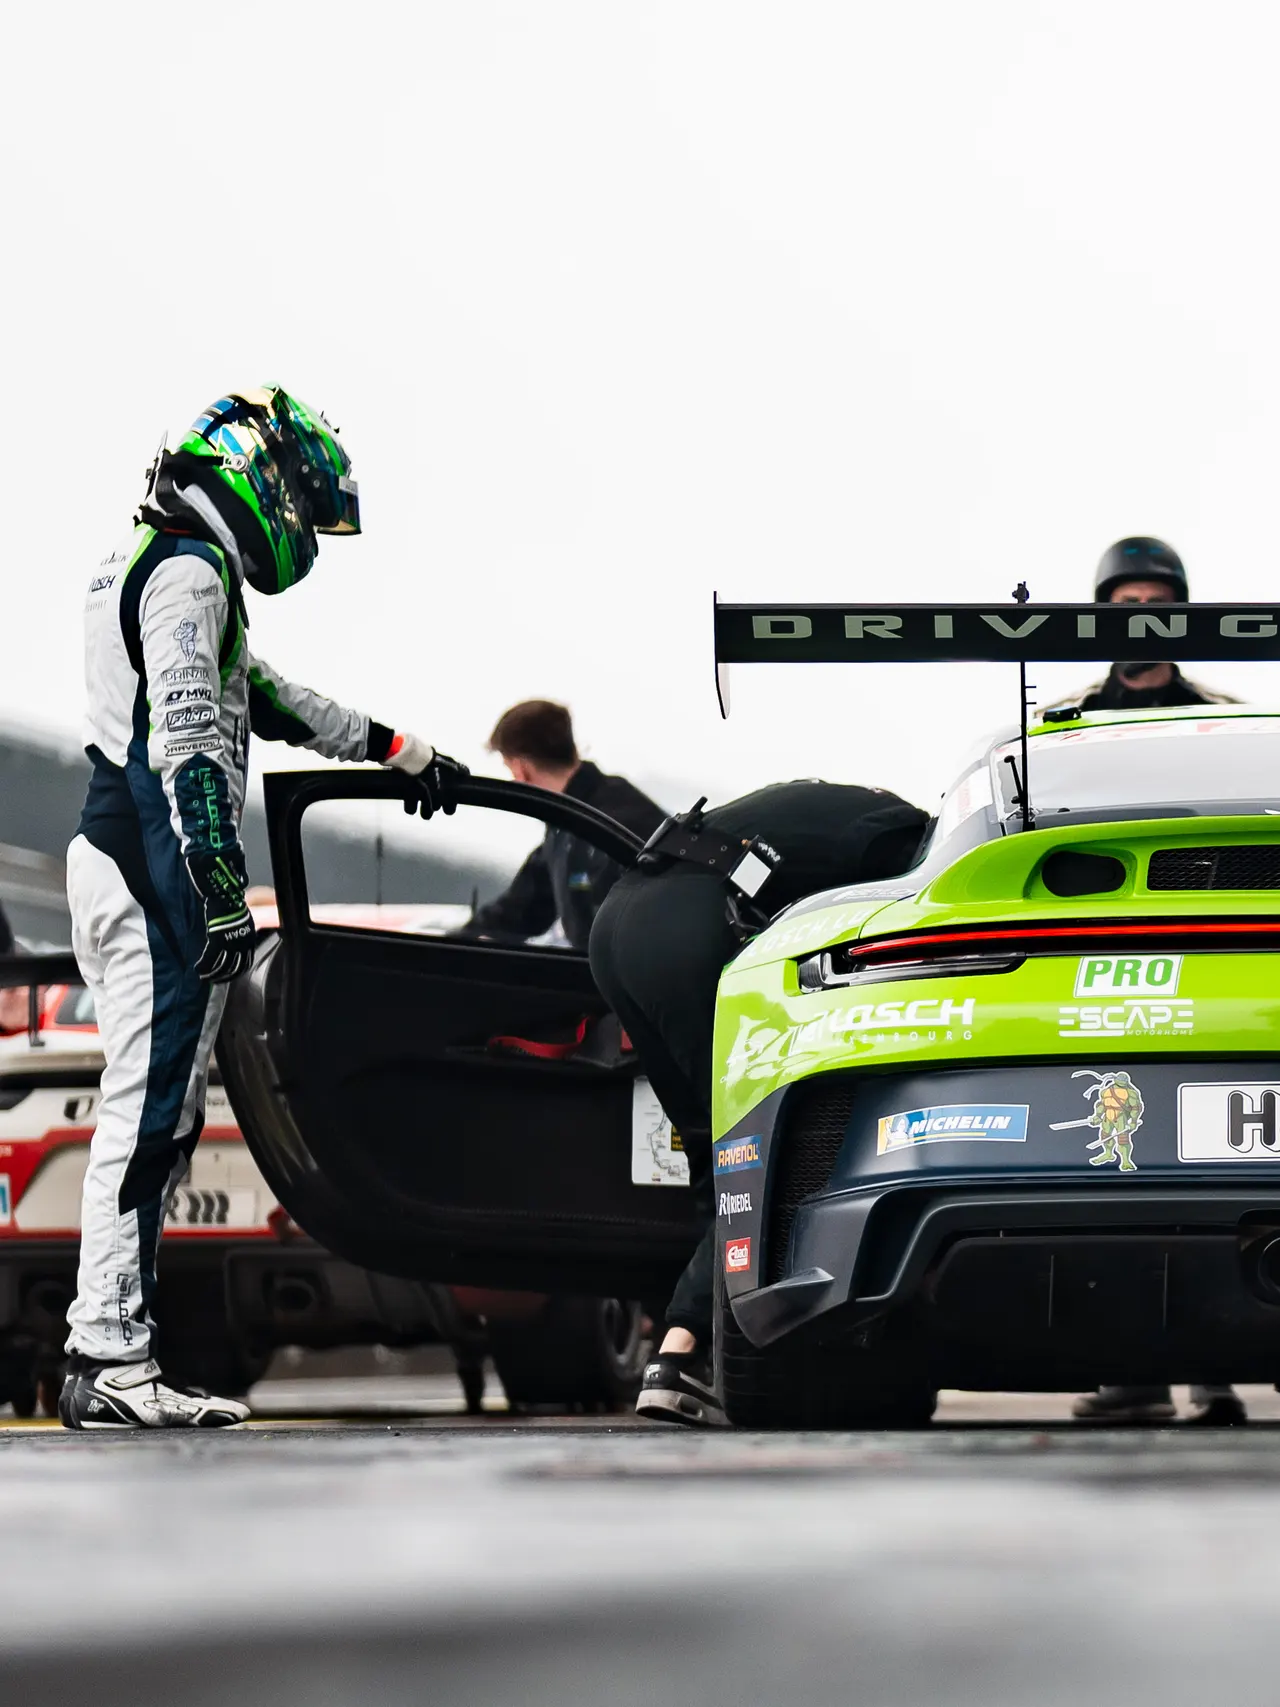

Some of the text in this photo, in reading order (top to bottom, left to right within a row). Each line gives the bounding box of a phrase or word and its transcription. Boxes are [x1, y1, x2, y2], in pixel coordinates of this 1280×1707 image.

[751, 614, 1278, 639] DRIVING
[1083, 958, 1174, 988] PRO
[829, 998, 976, 1033] LOSCH
[1059, 998, 1194, 1037] ESCAPE
[1125, 1028, 1194, 1037] MOTORHOME
[909, 1113, 1012, 1134] MICHELIN
[717, 1146, 760, 1169] RAVENOL
[730, 1192, 752, 1214] RIEDEL
